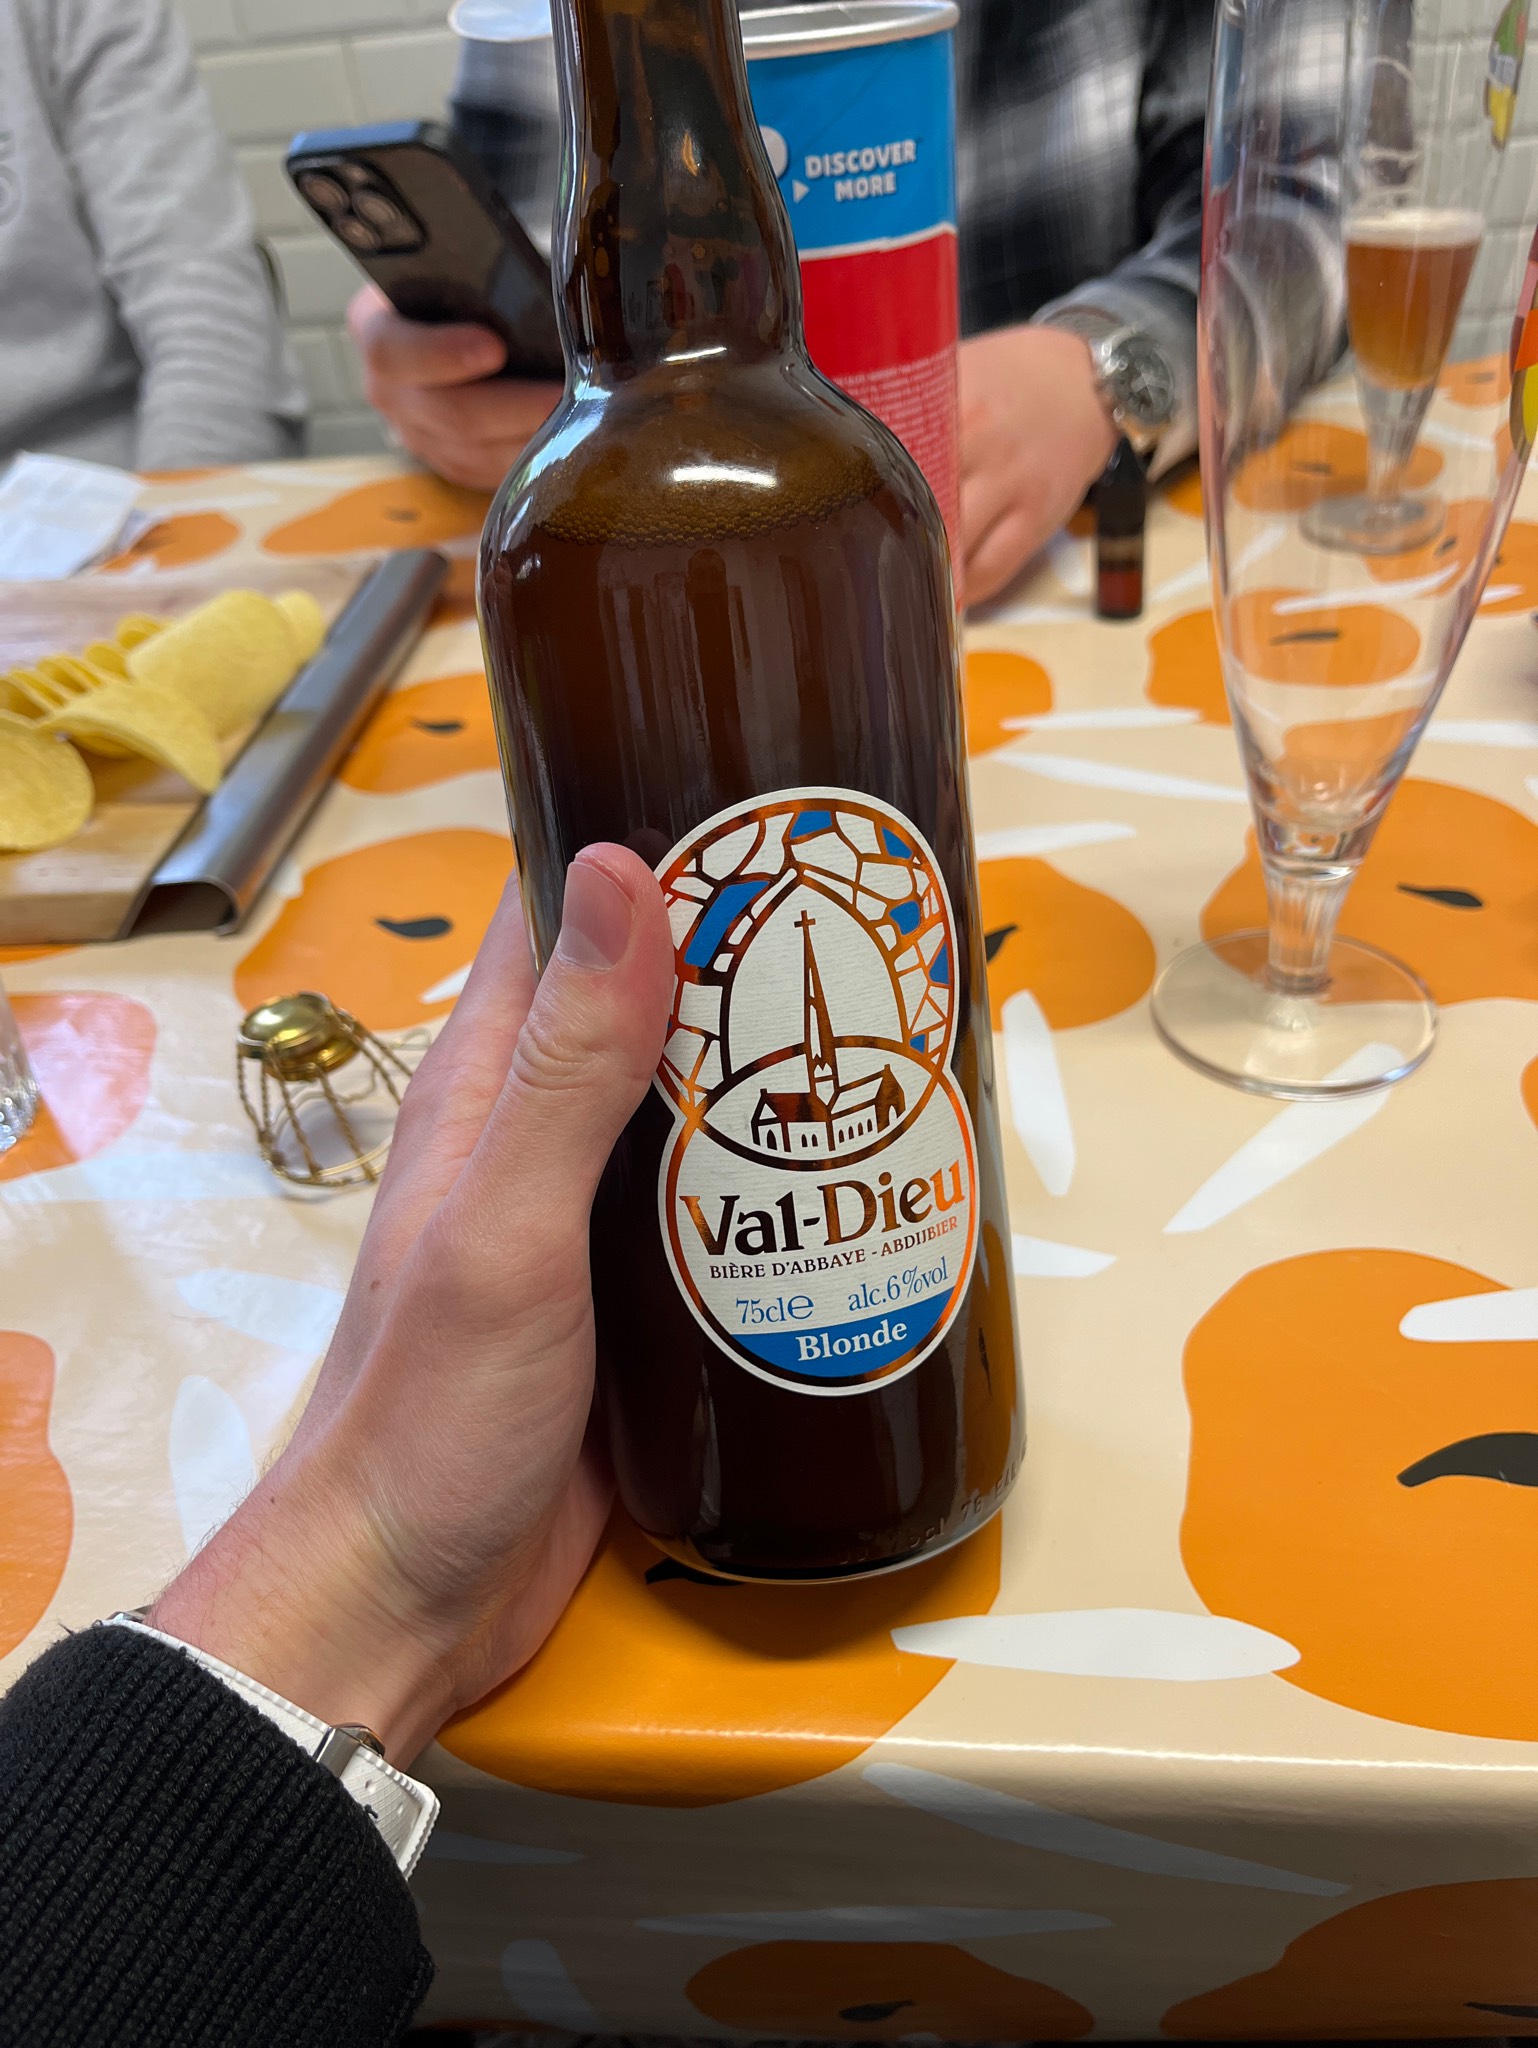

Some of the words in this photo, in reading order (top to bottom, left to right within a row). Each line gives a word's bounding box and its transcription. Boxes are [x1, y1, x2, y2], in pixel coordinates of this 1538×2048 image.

[805, 139, 917, 179] DISCOVER
[834, 171, 896, 202] MORE
[678, 1159, 966, 1256] Val-Dieu
[709, 1261, 766, 1279] BIÈRE
[771, 1248, 867, 1277] D'ABBAYE
[880, 1215, 958, 1257] ABDIJBIER
[795, 1320, 908, 1362] Blonde
